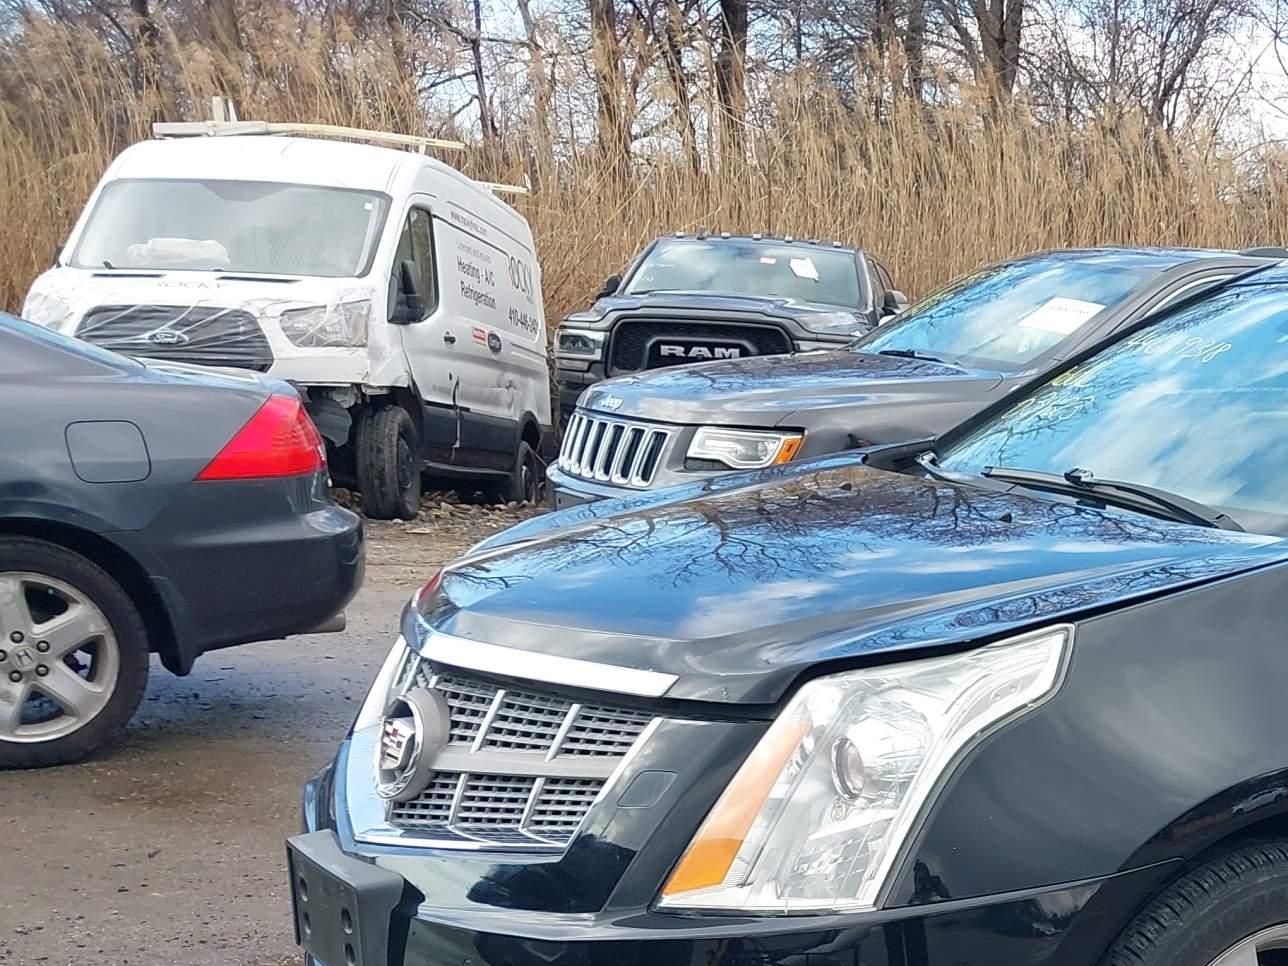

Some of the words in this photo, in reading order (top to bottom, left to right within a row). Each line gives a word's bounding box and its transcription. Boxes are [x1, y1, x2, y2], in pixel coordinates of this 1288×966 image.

[456, 255, 480, 284] Heating
[459, 279, 497, 310] Refrigeration
[660, 344, 740, 358] RAM
[600, 394, 624, 410] Jeep
